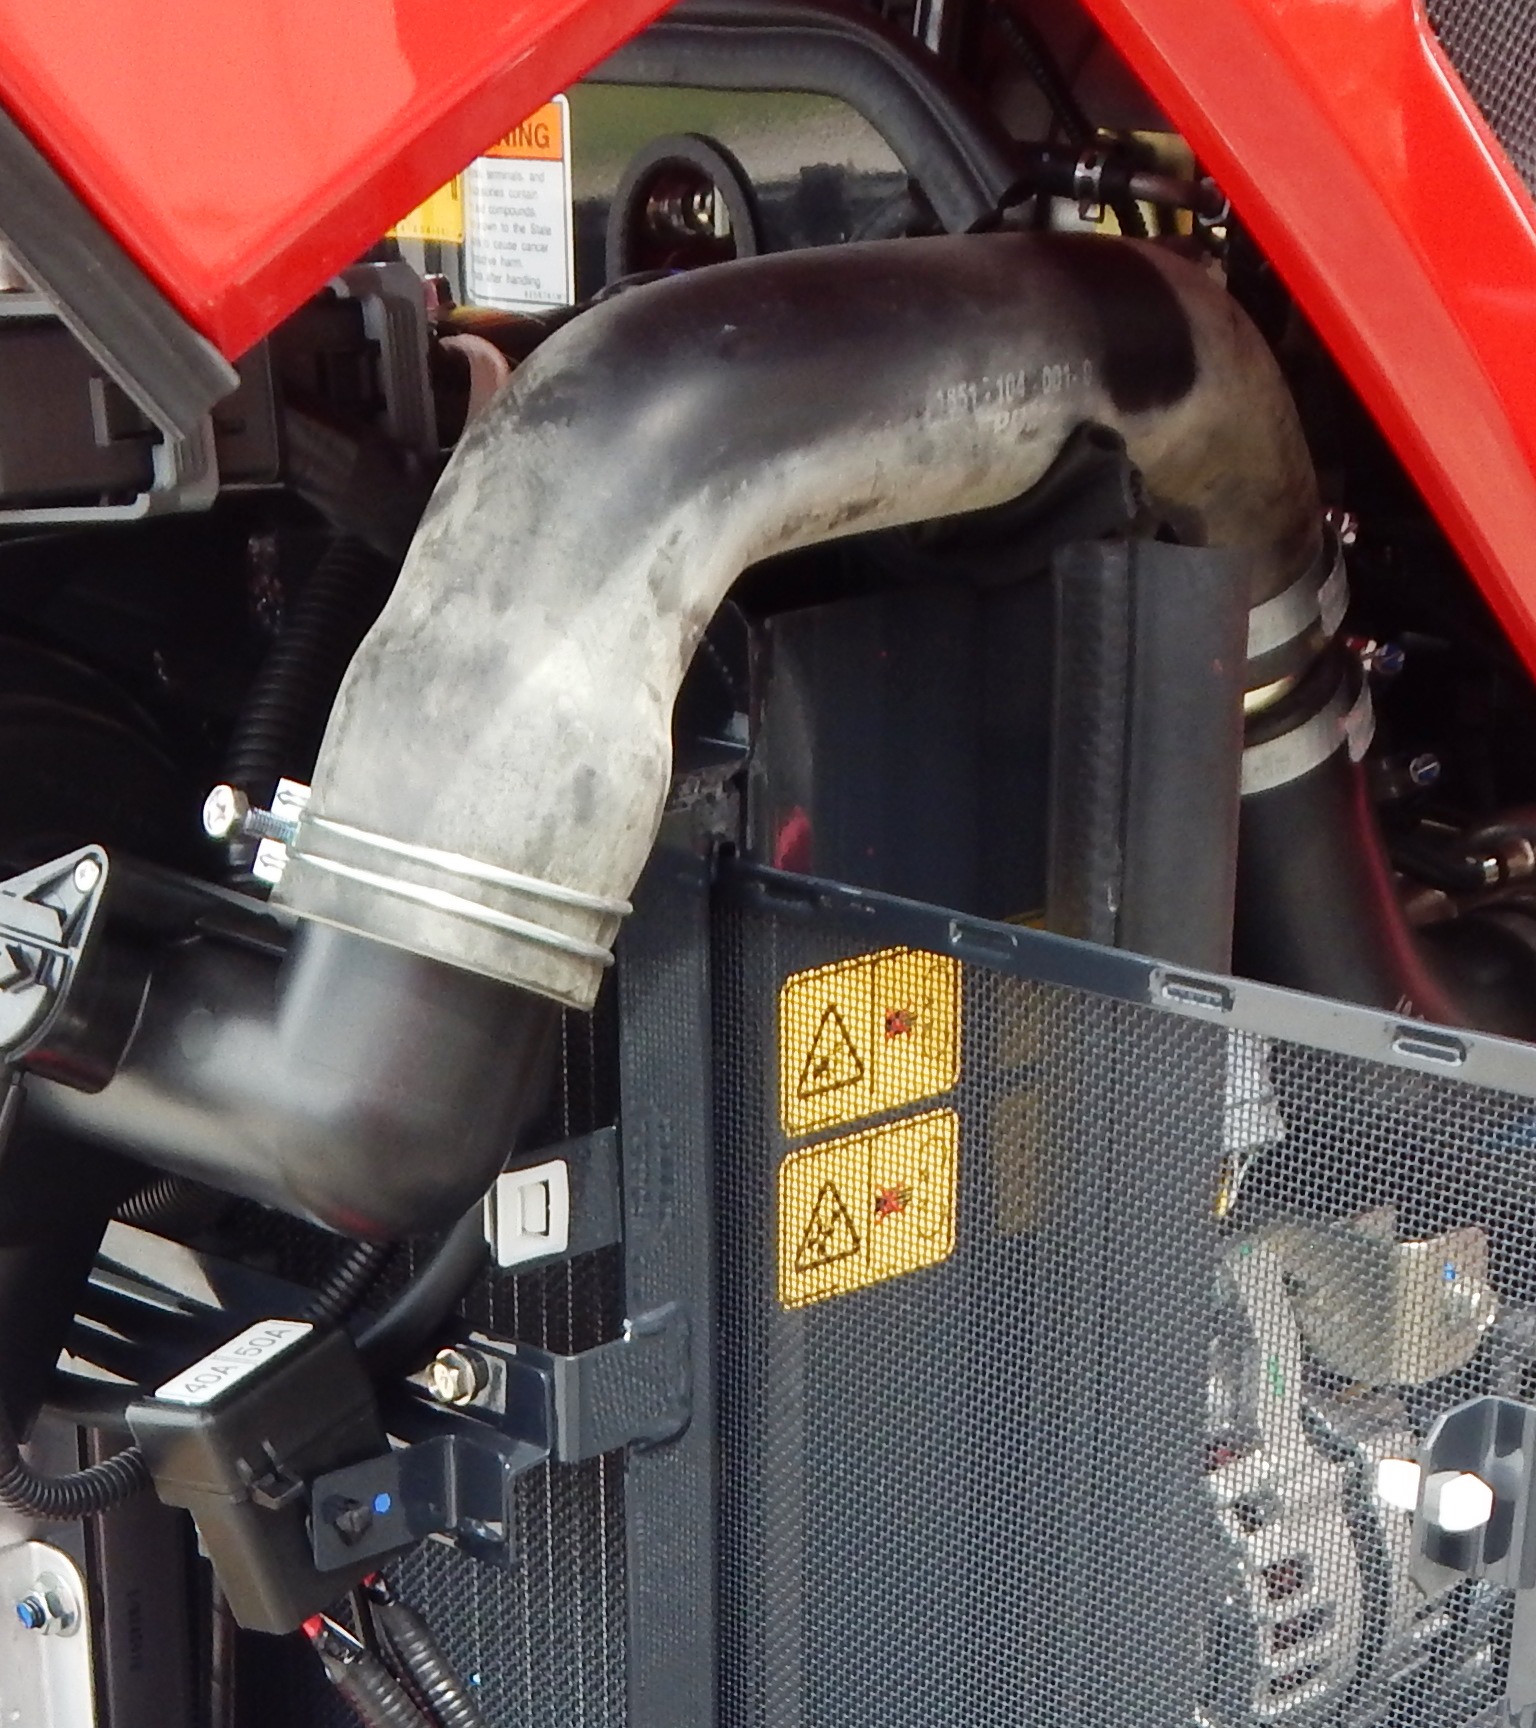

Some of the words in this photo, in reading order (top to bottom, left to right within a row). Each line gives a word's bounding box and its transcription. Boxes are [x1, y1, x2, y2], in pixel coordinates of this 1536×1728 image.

[512, 222, 527, 234] the
[184, 1363, 239, 1396] 40A
[234, 1327, 292, 1359] 50A
